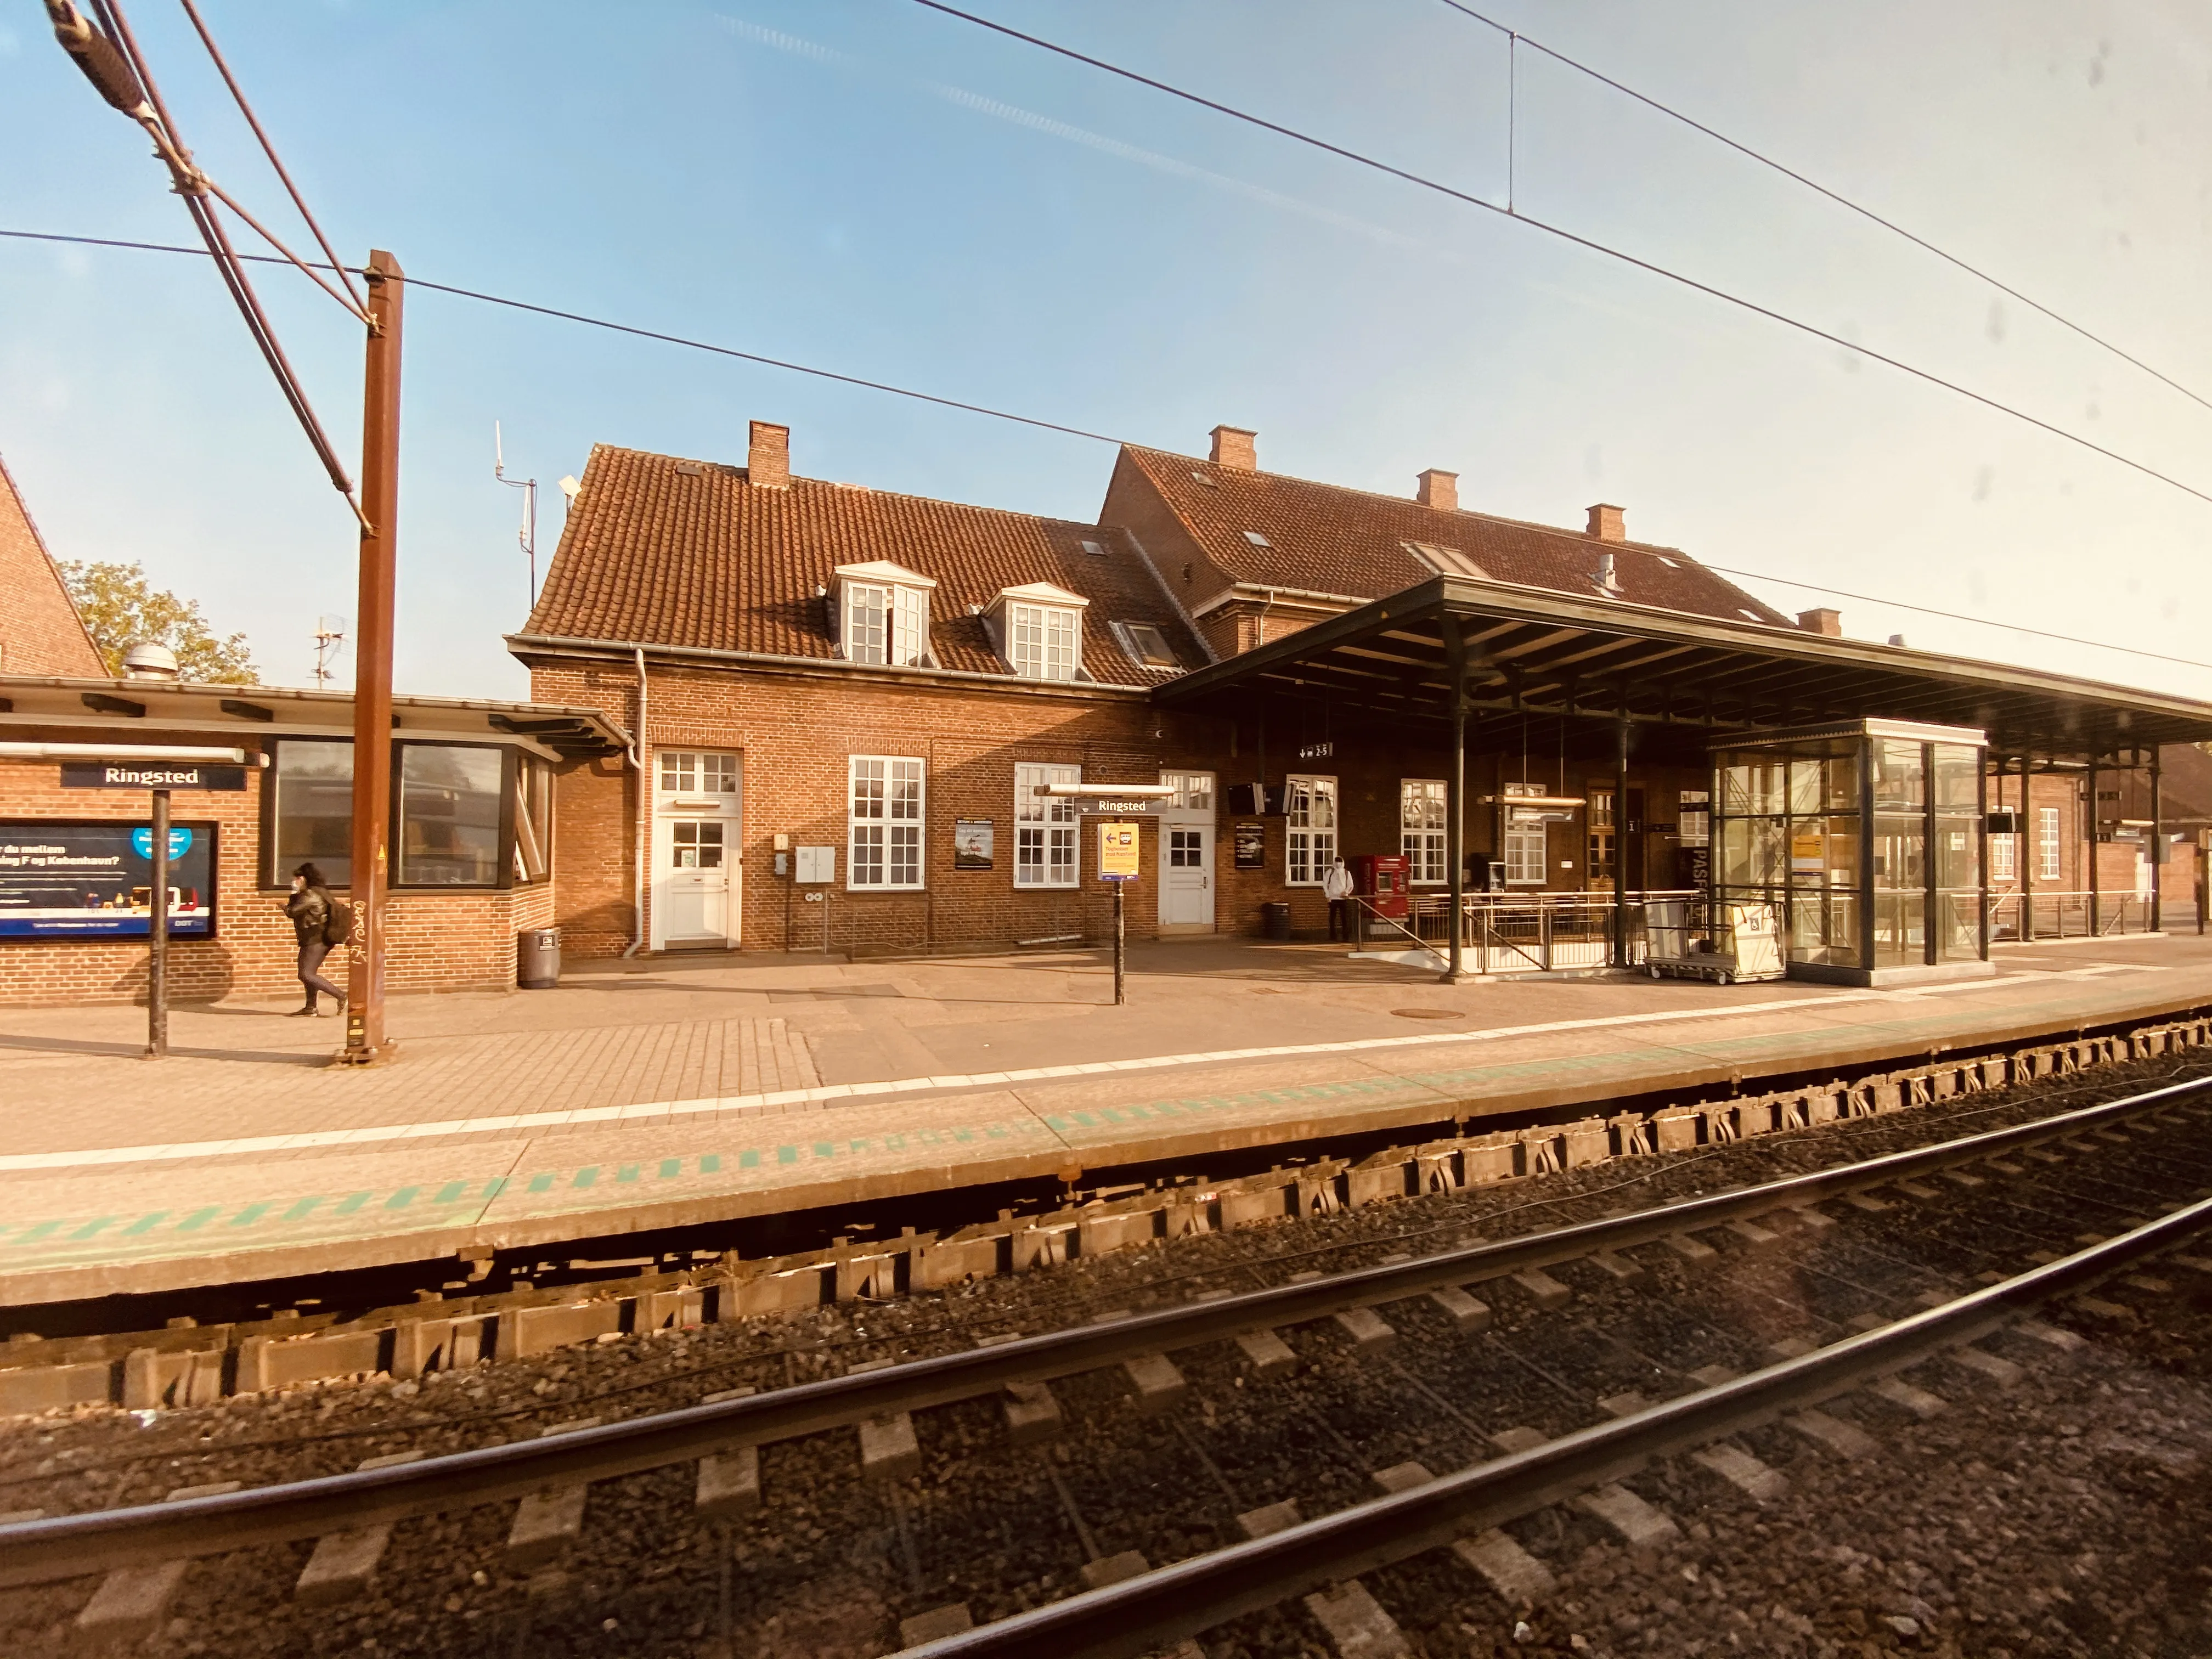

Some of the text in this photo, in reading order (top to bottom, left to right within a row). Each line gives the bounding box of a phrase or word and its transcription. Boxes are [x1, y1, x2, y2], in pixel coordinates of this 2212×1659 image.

[1316, 747, 1327, 757] 2-5
[105, 768, 199, 785] Ringsted
[1099, 800, 1146, 812] Ringsted
[4, 845, 19, 854] du
[21, 845, 66, 854] mellem
[0, 855, 120, 867] ing F og København?
